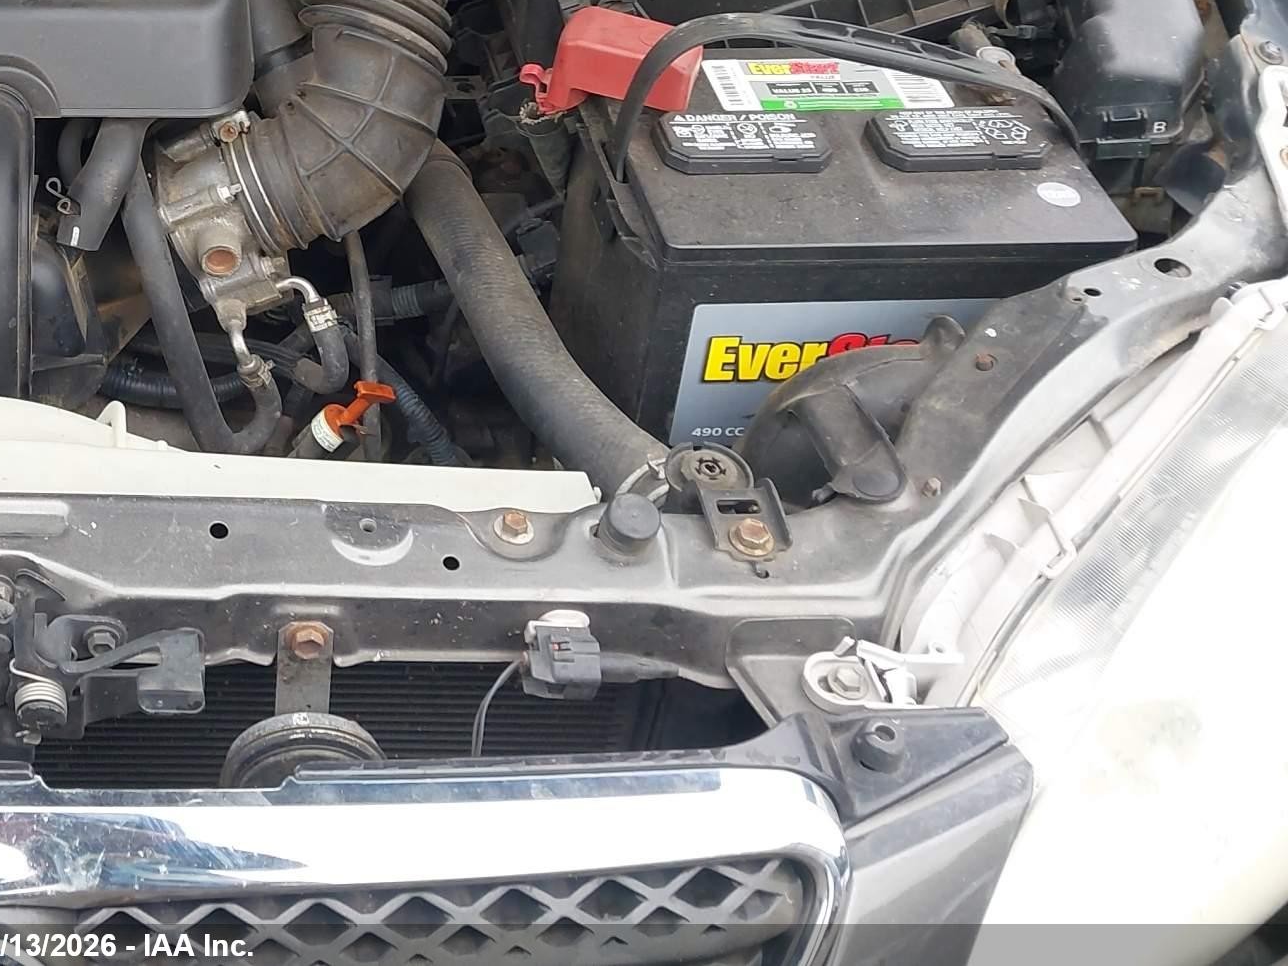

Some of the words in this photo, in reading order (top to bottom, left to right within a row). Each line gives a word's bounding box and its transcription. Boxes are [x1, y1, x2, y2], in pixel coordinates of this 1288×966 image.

[685, 114, 737, 122] DANGER
[750, 113, 797, 121] POISON
[1153, 121, 1167, 133] B
[691, 427, 722, 437] 490
